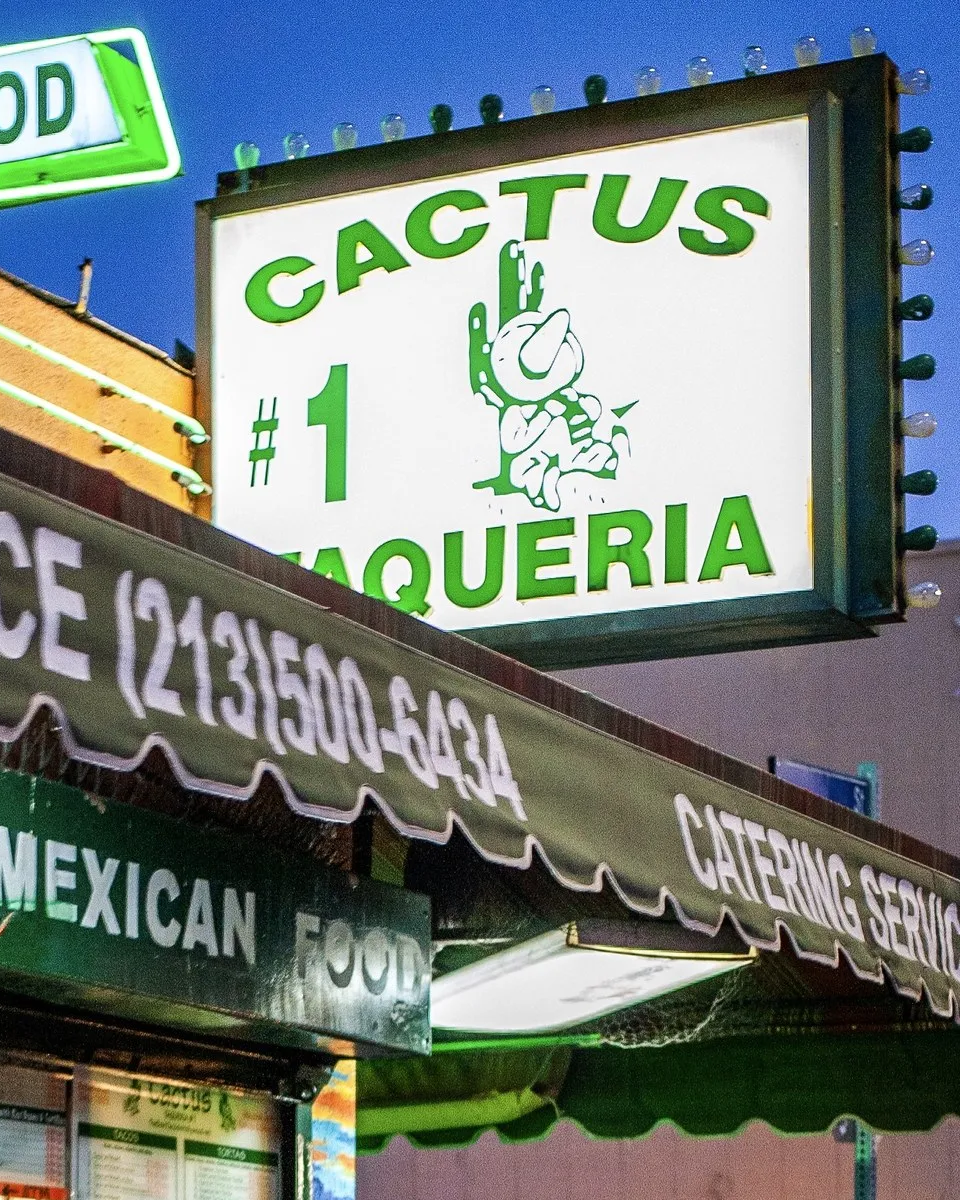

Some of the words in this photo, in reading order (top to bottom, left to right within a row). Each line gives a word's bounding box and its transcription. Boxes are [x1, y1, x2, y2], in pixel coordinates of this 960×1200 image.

[244, 173, 772, 326] CACTUS
[276, 495, 776, 617] QUERIA
[674, 793, 865, 943] CATERING
[295, 911, 424, 995] FOOD
